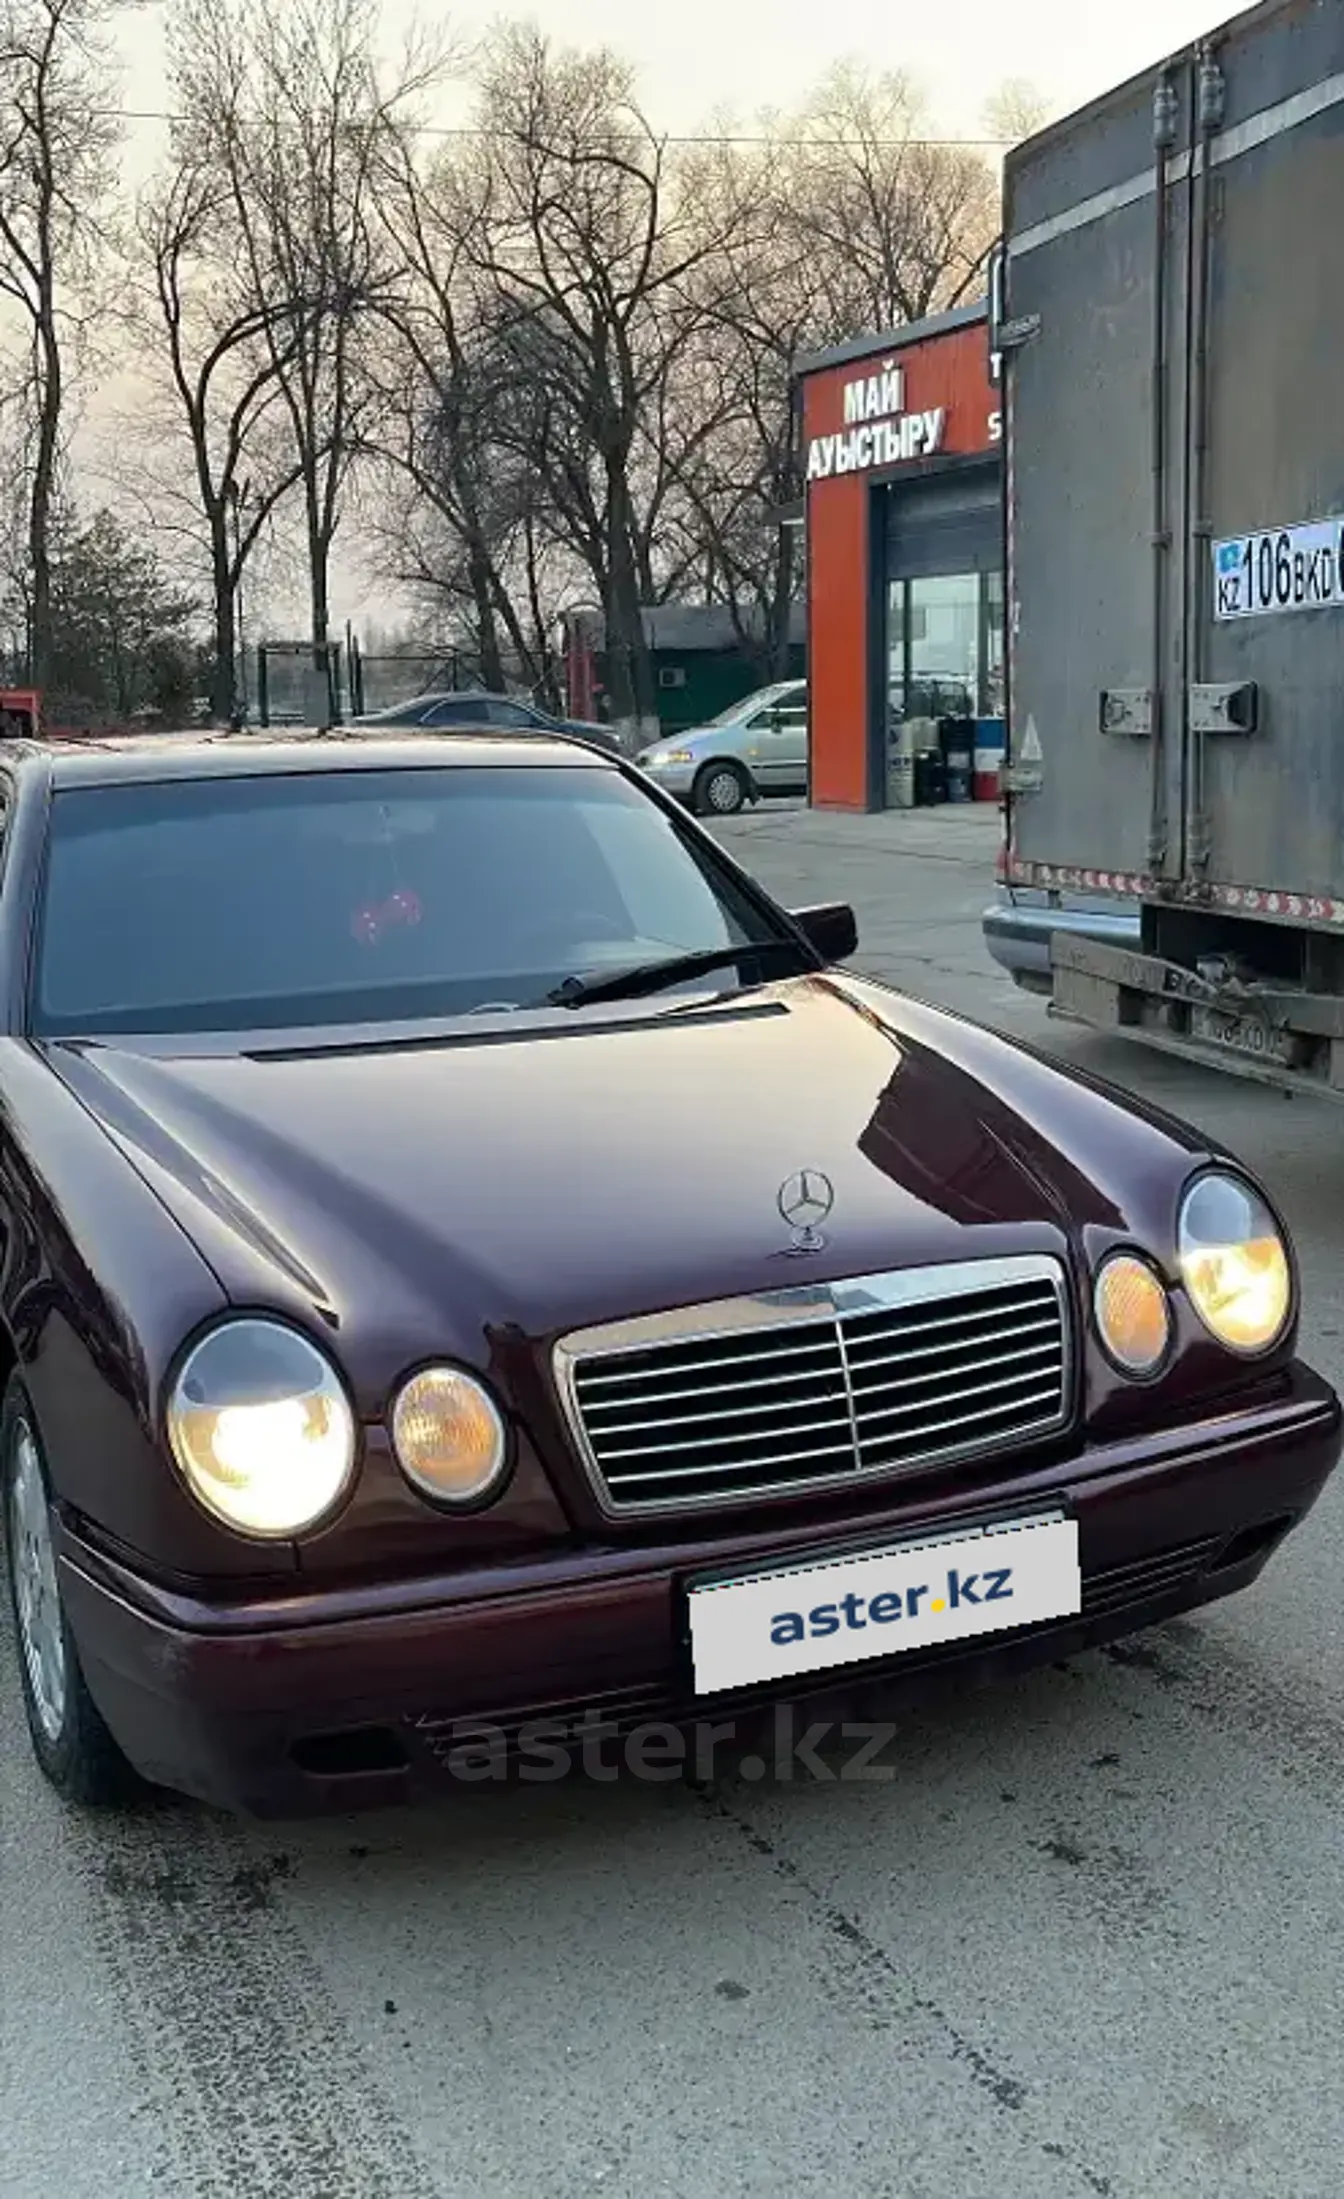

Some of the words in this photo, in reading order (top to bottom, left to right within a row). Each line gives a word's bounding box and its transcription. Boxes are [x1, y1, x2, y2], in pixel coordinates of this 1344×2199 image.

[844, 358, 904, 424] МАЙ
[806, 407, 945, 480] АУЫСТЫРУ
[1219, 577, 1240, 612] KZ
